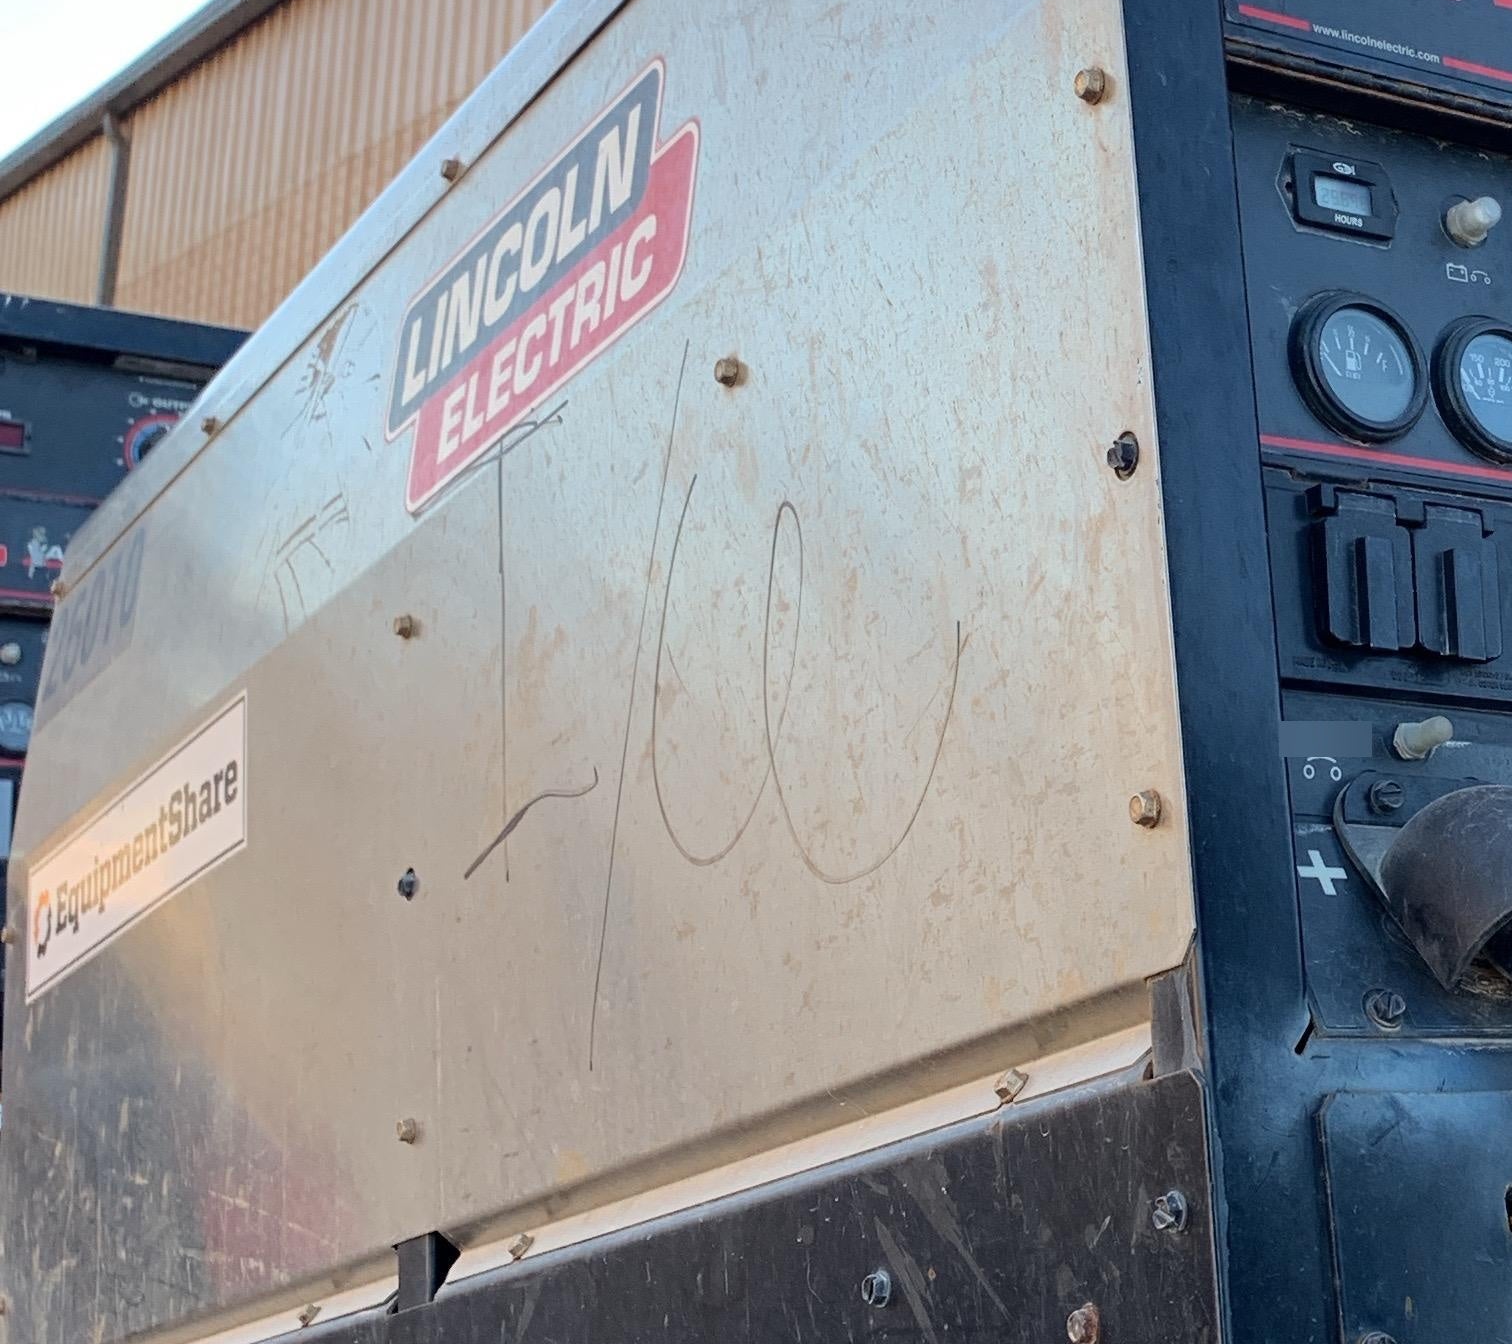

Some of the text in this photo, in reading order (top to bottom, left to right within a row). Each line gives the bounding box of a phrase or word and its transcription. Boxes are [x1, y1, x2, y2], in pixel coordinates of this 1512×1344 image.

[1312, 22, 1441, 65] www.lincolnelectric.com
[401, 103, 642, 408] LINCOLN
[1334, 213, 1364, 228] HOURS
[435, 212, 659, 465] ELECTRIC
[55, 758, 240, 937] EquipmentShare
